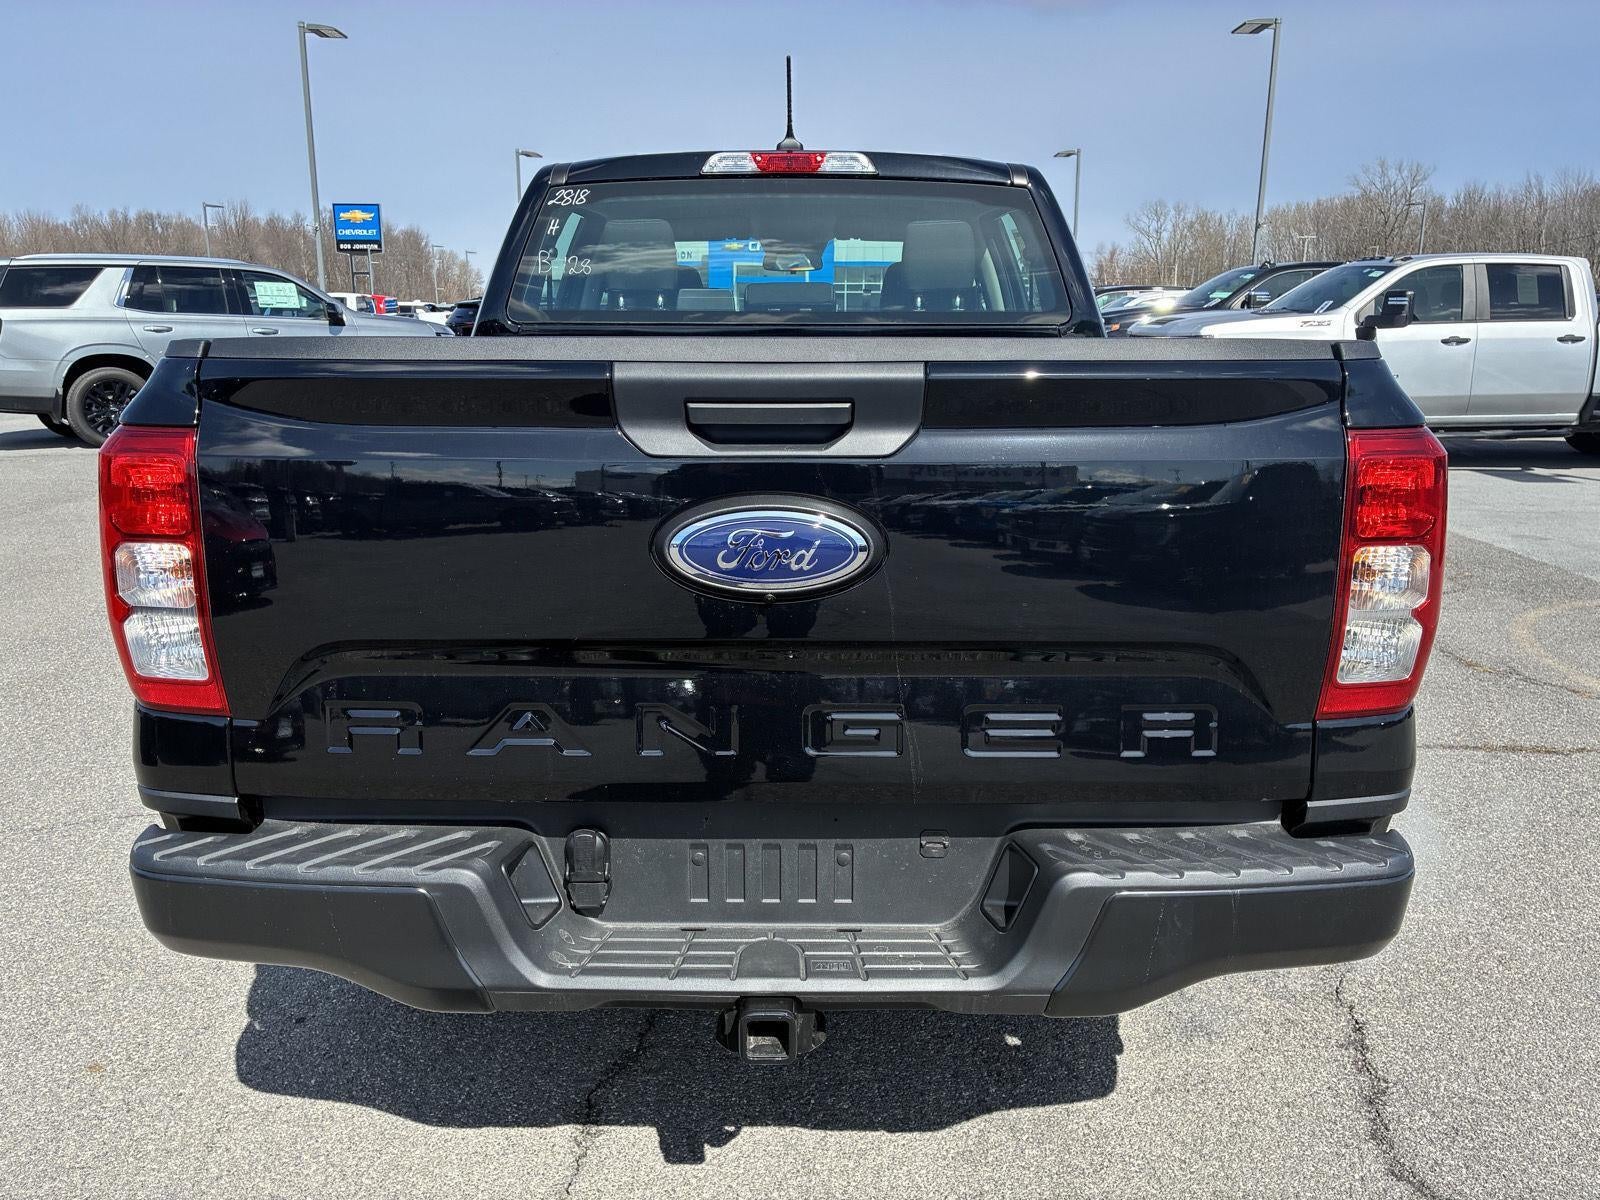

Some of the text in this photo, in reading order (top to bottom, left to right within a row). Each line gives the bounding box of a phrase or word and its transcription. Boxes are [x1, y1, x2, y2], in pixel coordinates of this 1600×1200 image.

[547, 189, 591, 206] 2818
[338, 228, 377, 236] CHEVROLET
[547, 218, 560, 236] H
[716, 527, 821, 571] Ford
[323, 702, 1219, 758] RANGER
